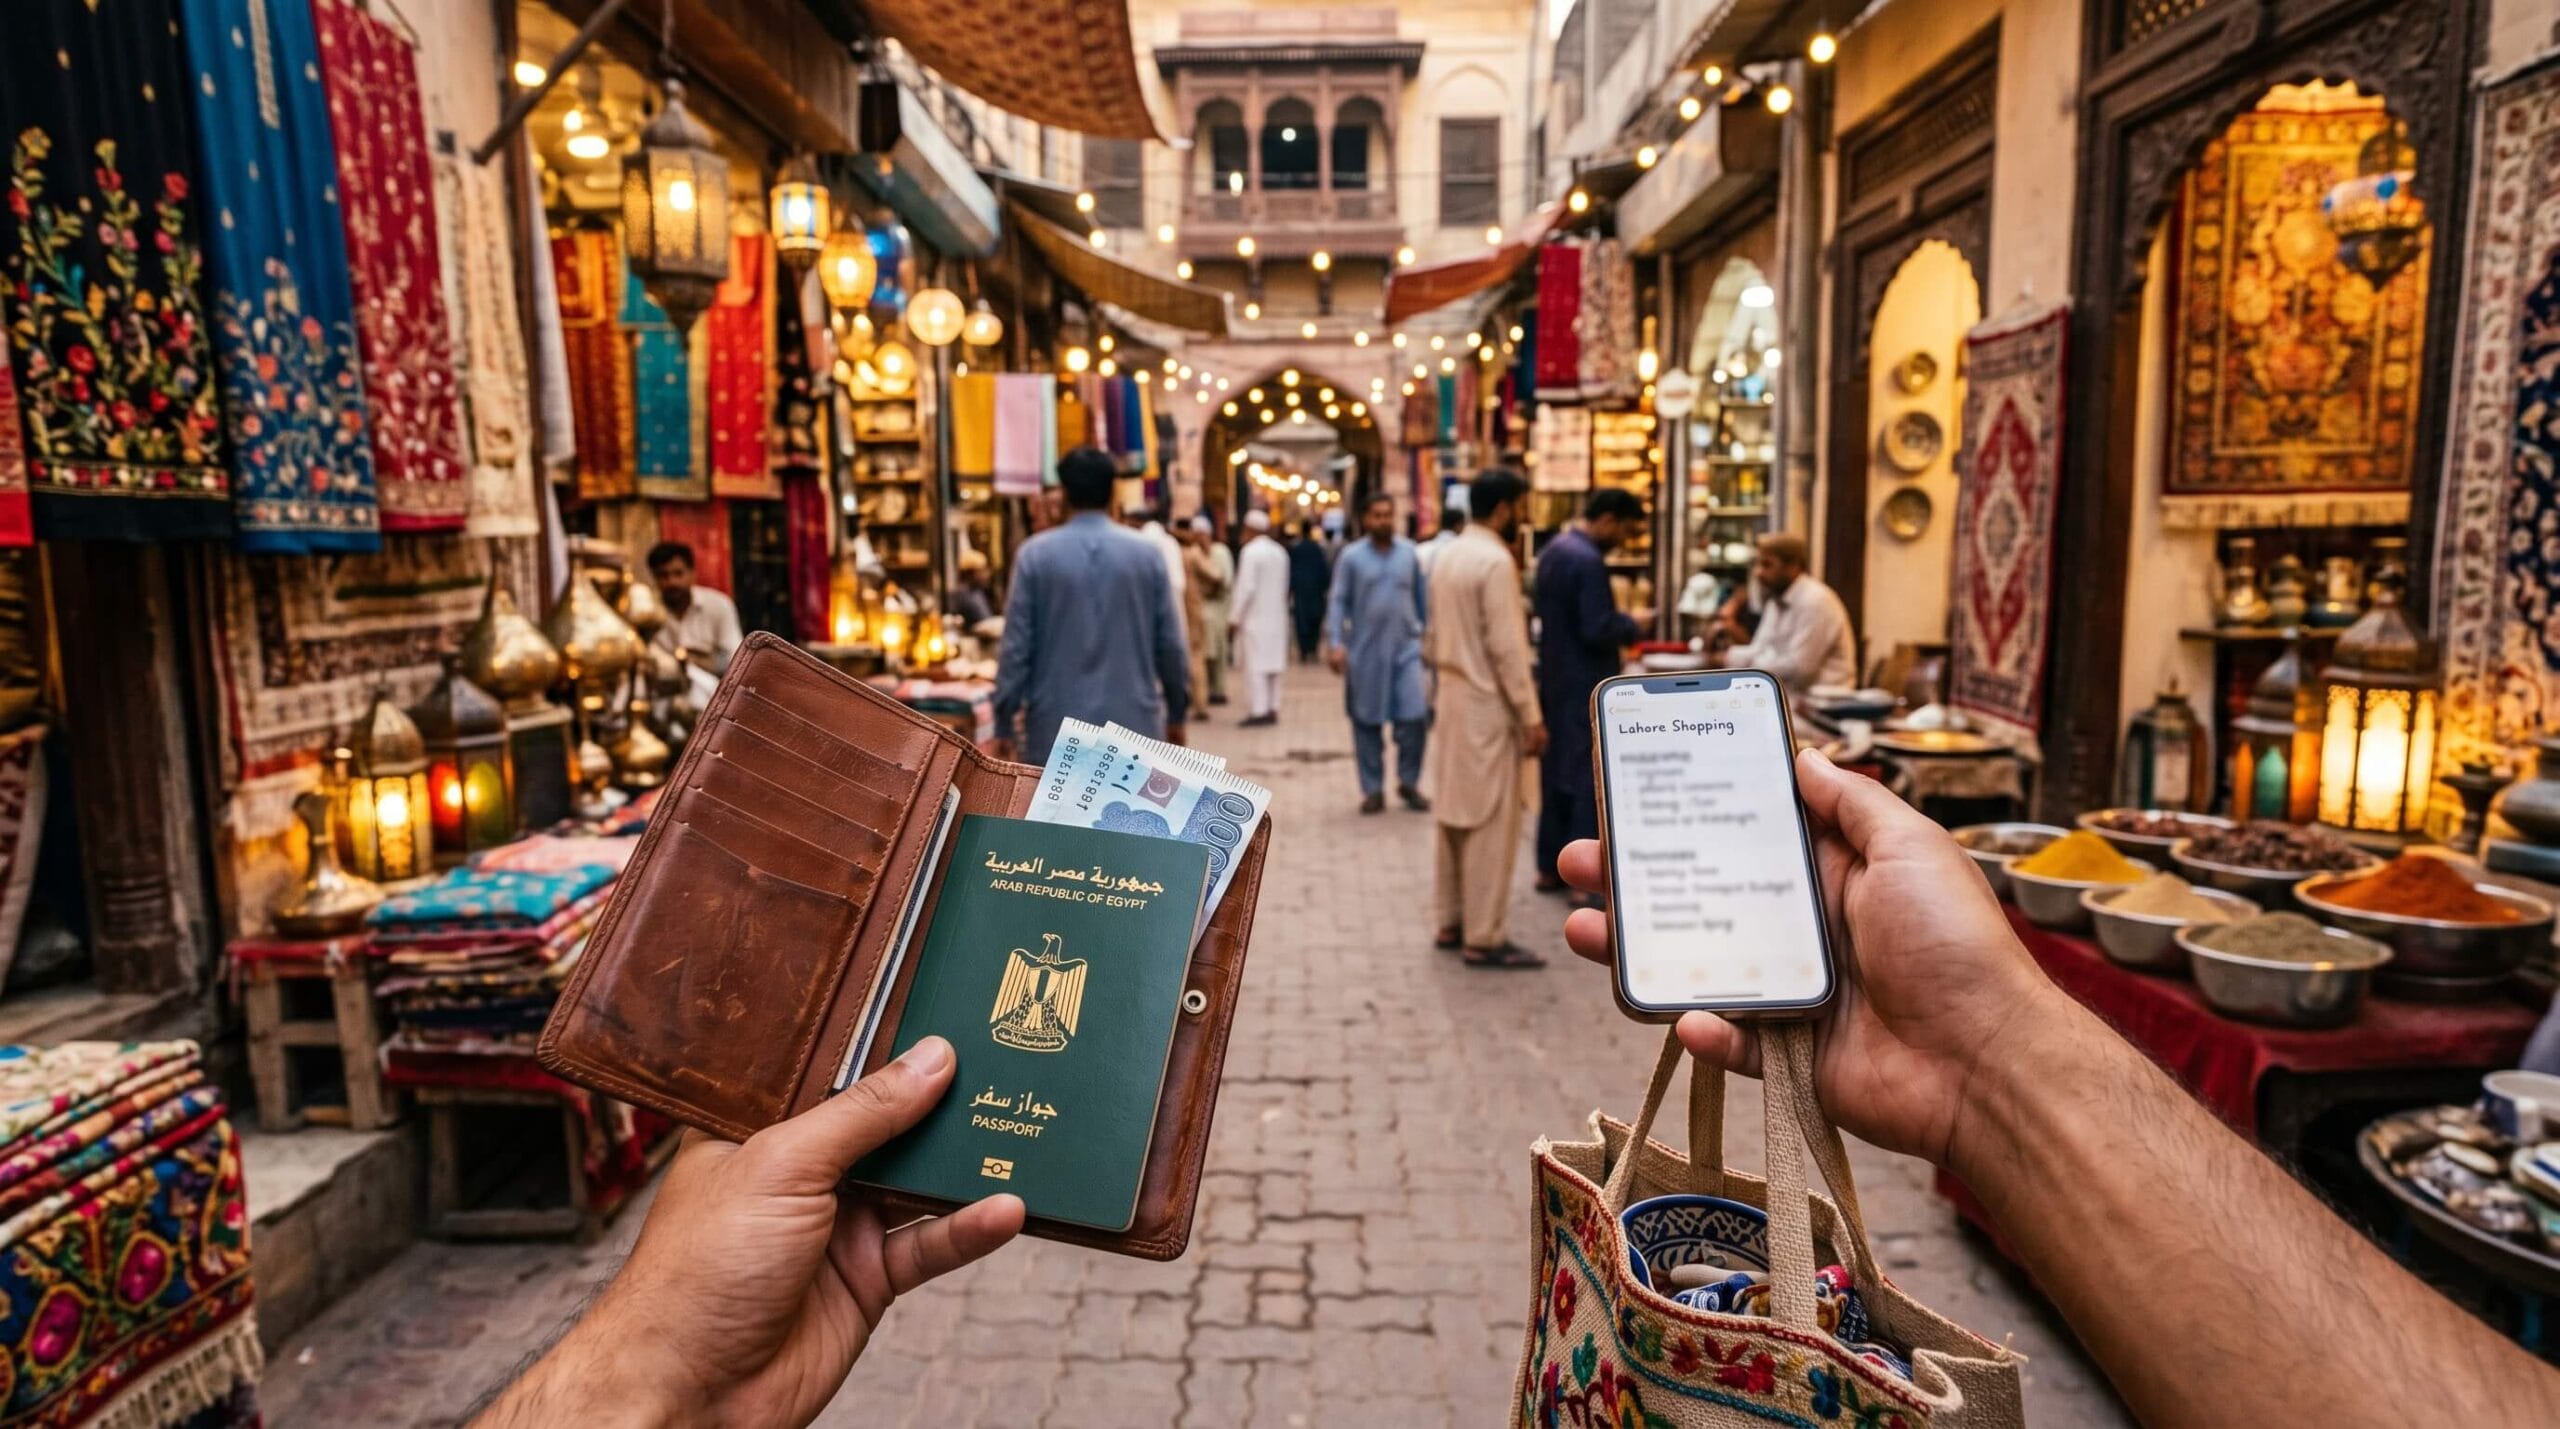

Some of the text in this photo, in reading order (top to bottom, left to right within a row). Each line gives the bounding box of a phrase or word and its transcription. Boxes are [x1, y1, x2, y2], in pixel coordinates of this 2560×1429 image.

[1619, 719, 1735, 736] Lahore Shopping
[984, 851, 1164, 896] جمهورية مصر العربية
[990, 879, 1148, 910] ARAB REPUBLIC OF EGYPT
[969, 1085, 1058, 1120] جواز سفر
[971, 1114, 1044, 1138] PASSPORT
